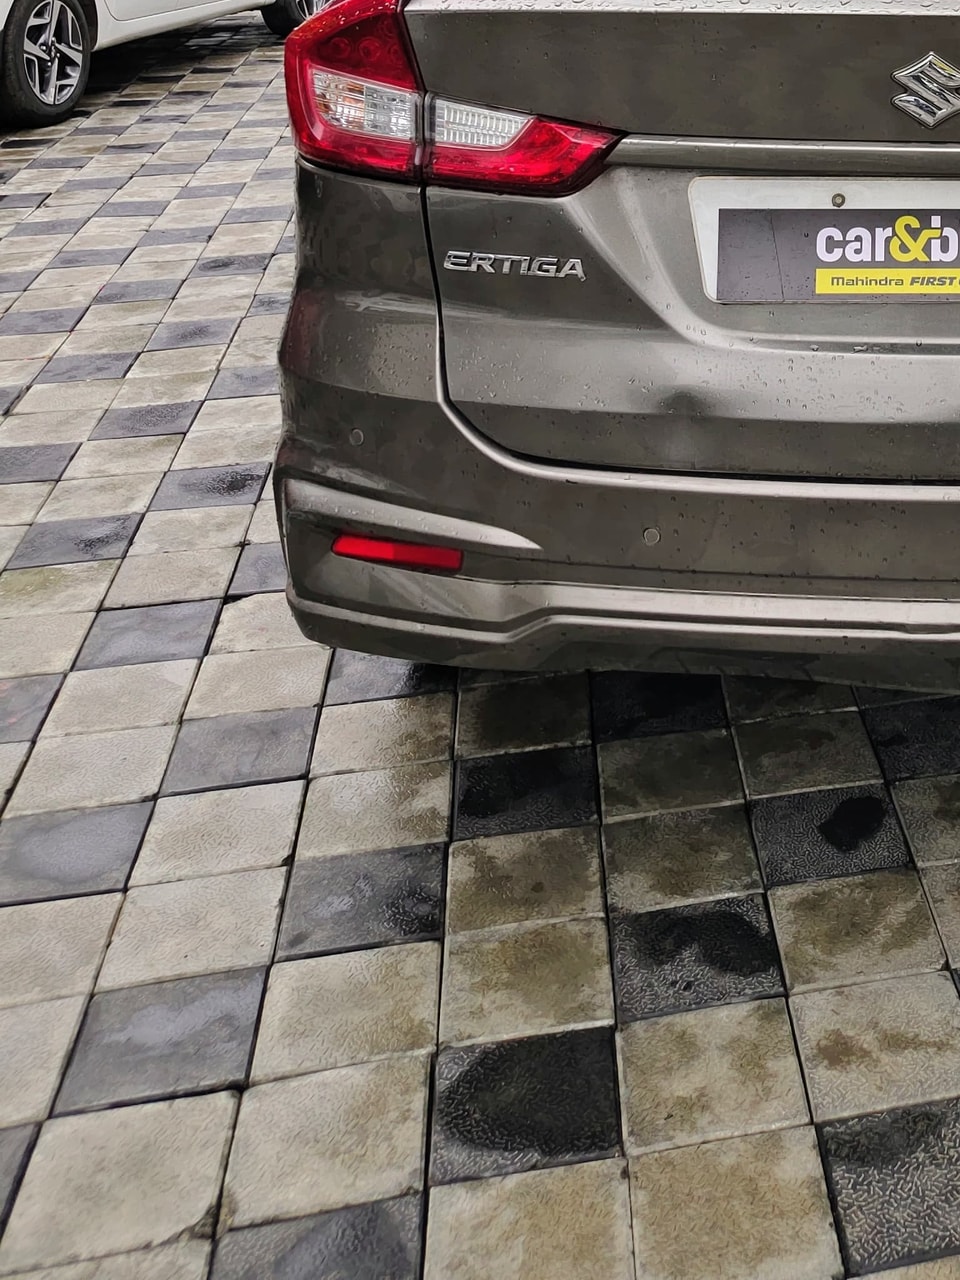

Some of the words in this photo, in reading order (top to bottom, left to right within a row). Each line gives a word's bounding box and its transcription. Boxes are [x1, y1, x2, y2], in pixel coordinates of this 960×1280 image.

[443, 250, 586, 281] ERTIGA
[830, 276, 904, 287] Mahindra
[909, 275, 957, 287] FIRST
